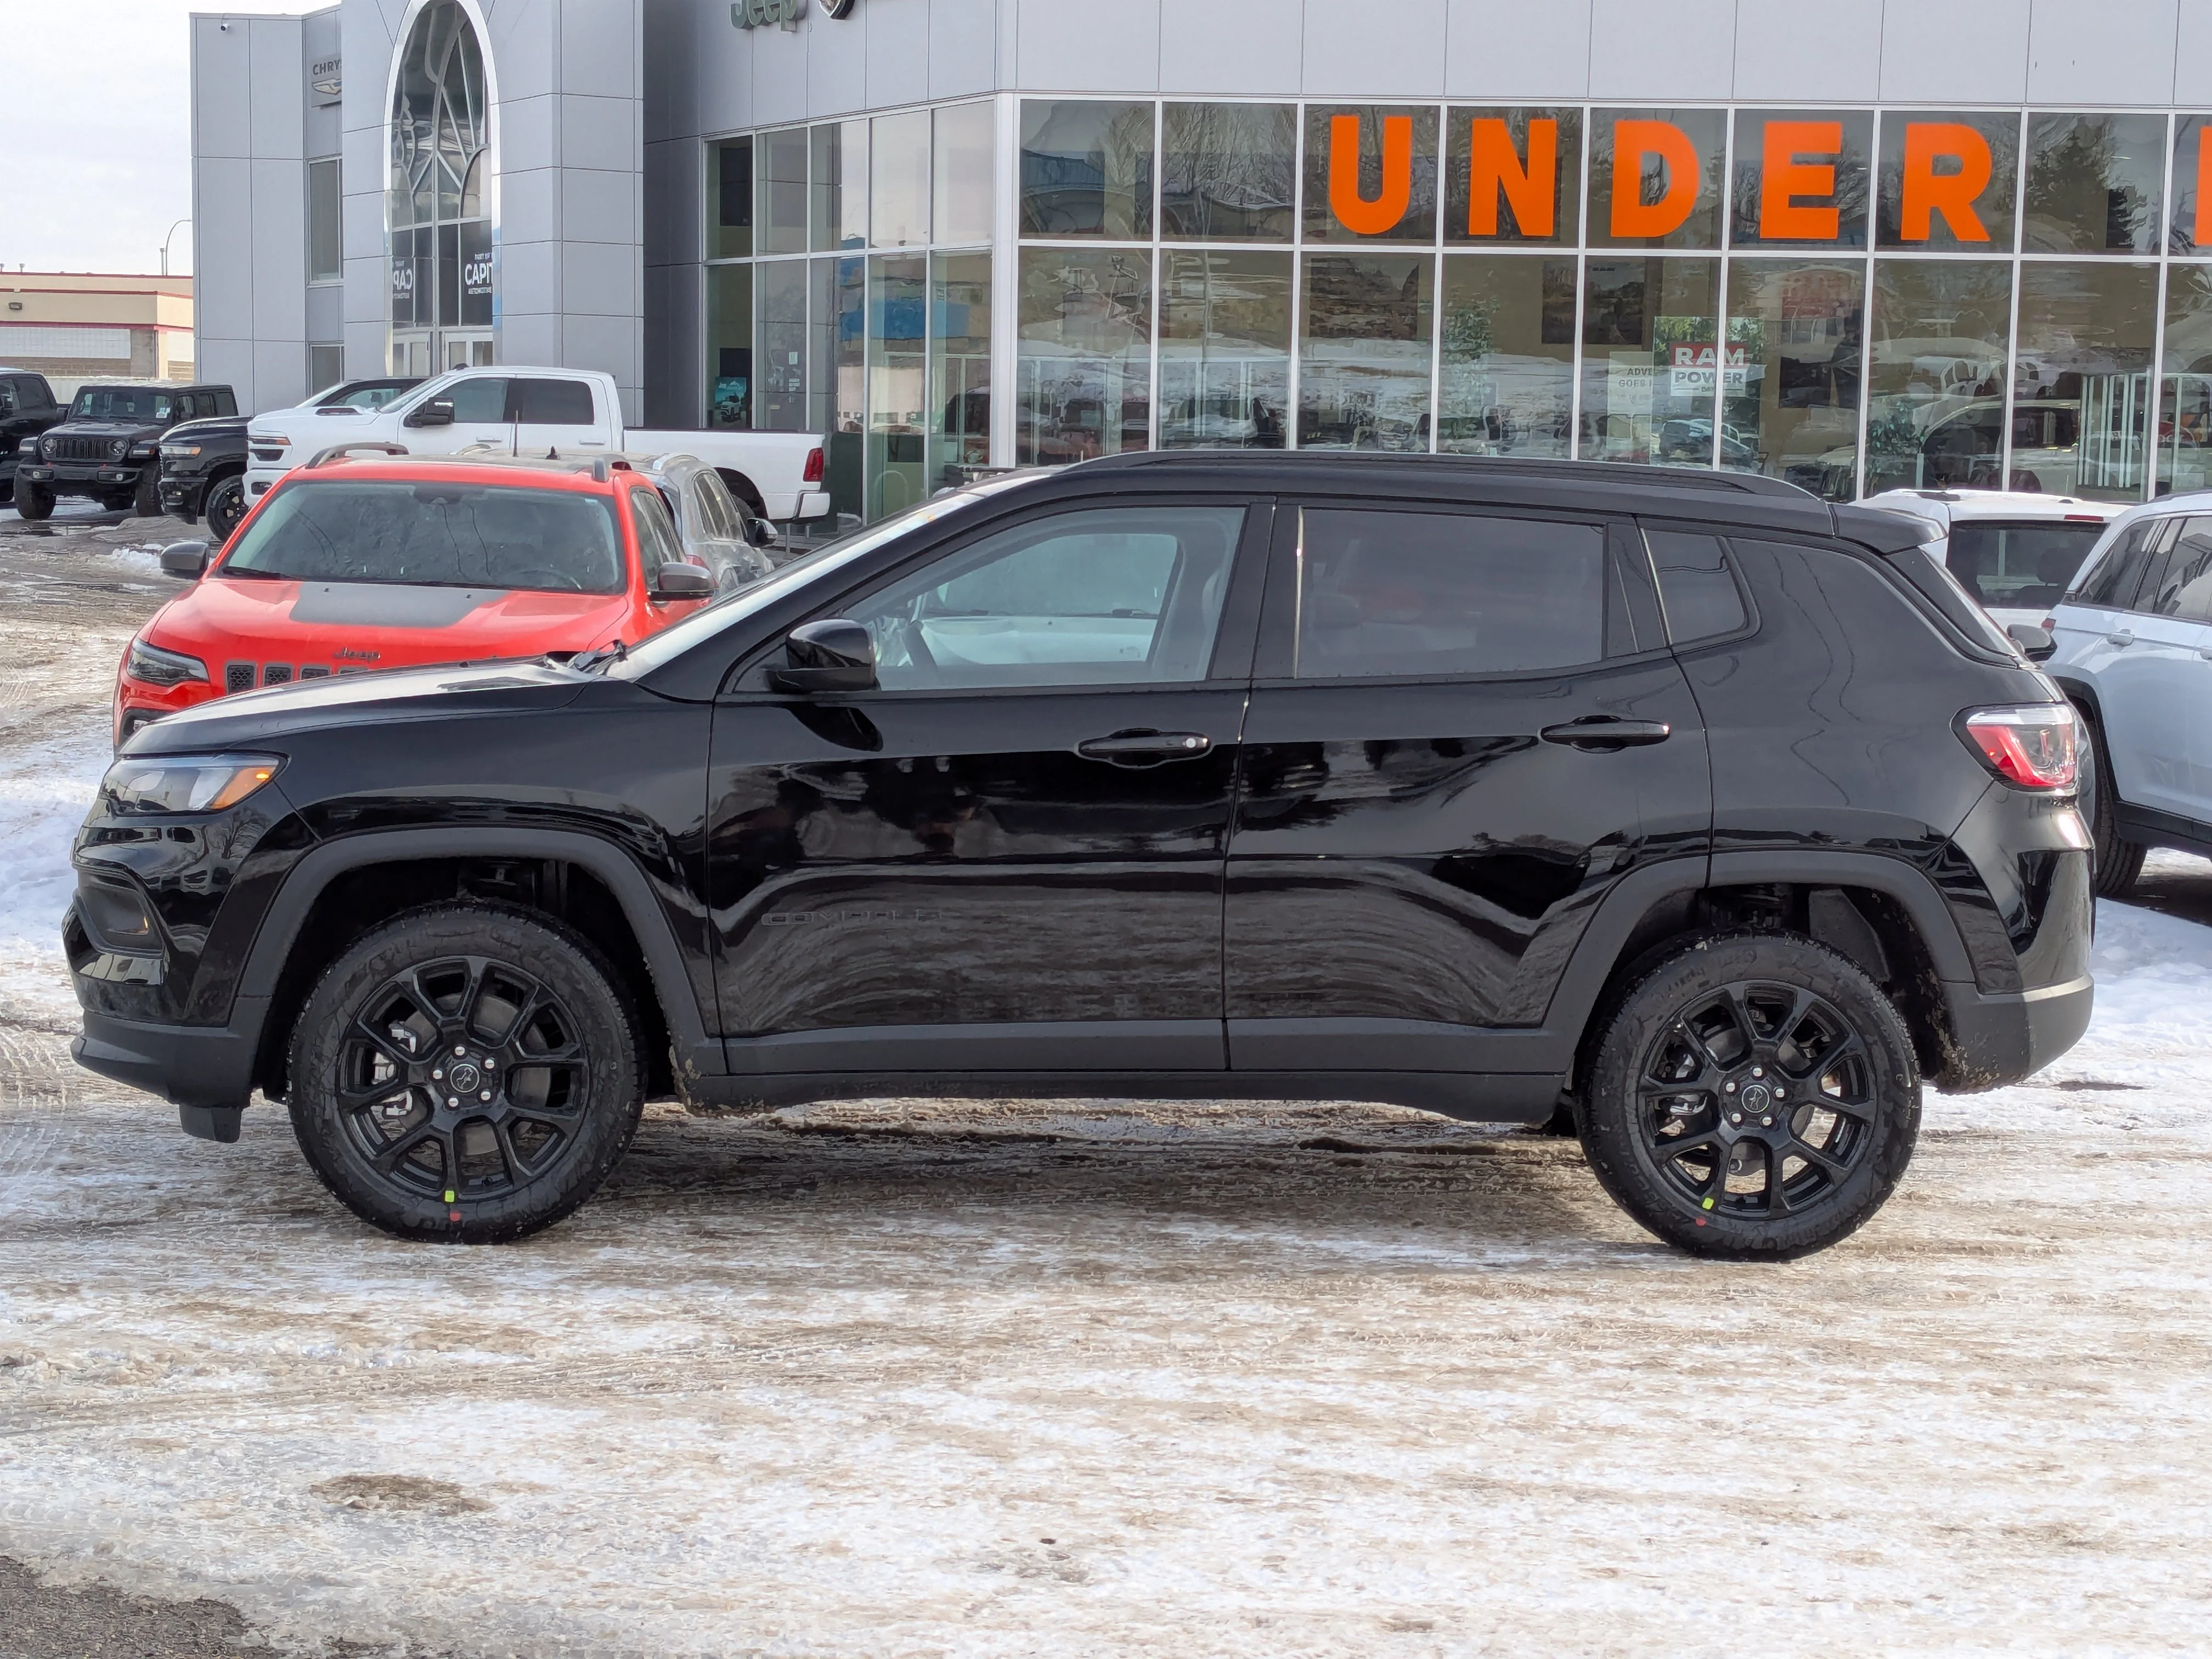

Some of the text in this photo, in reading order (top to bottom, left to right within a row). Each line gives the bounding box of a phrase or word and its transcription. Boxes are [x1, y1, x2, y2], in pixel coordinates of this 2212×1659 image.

[313, 59, 342, 75] CHRY
[1330, 117, 1990, 240] UNDER
[1675, 347, 1744, 366] RAM
[1675, 372, 1743, 383] POWER
